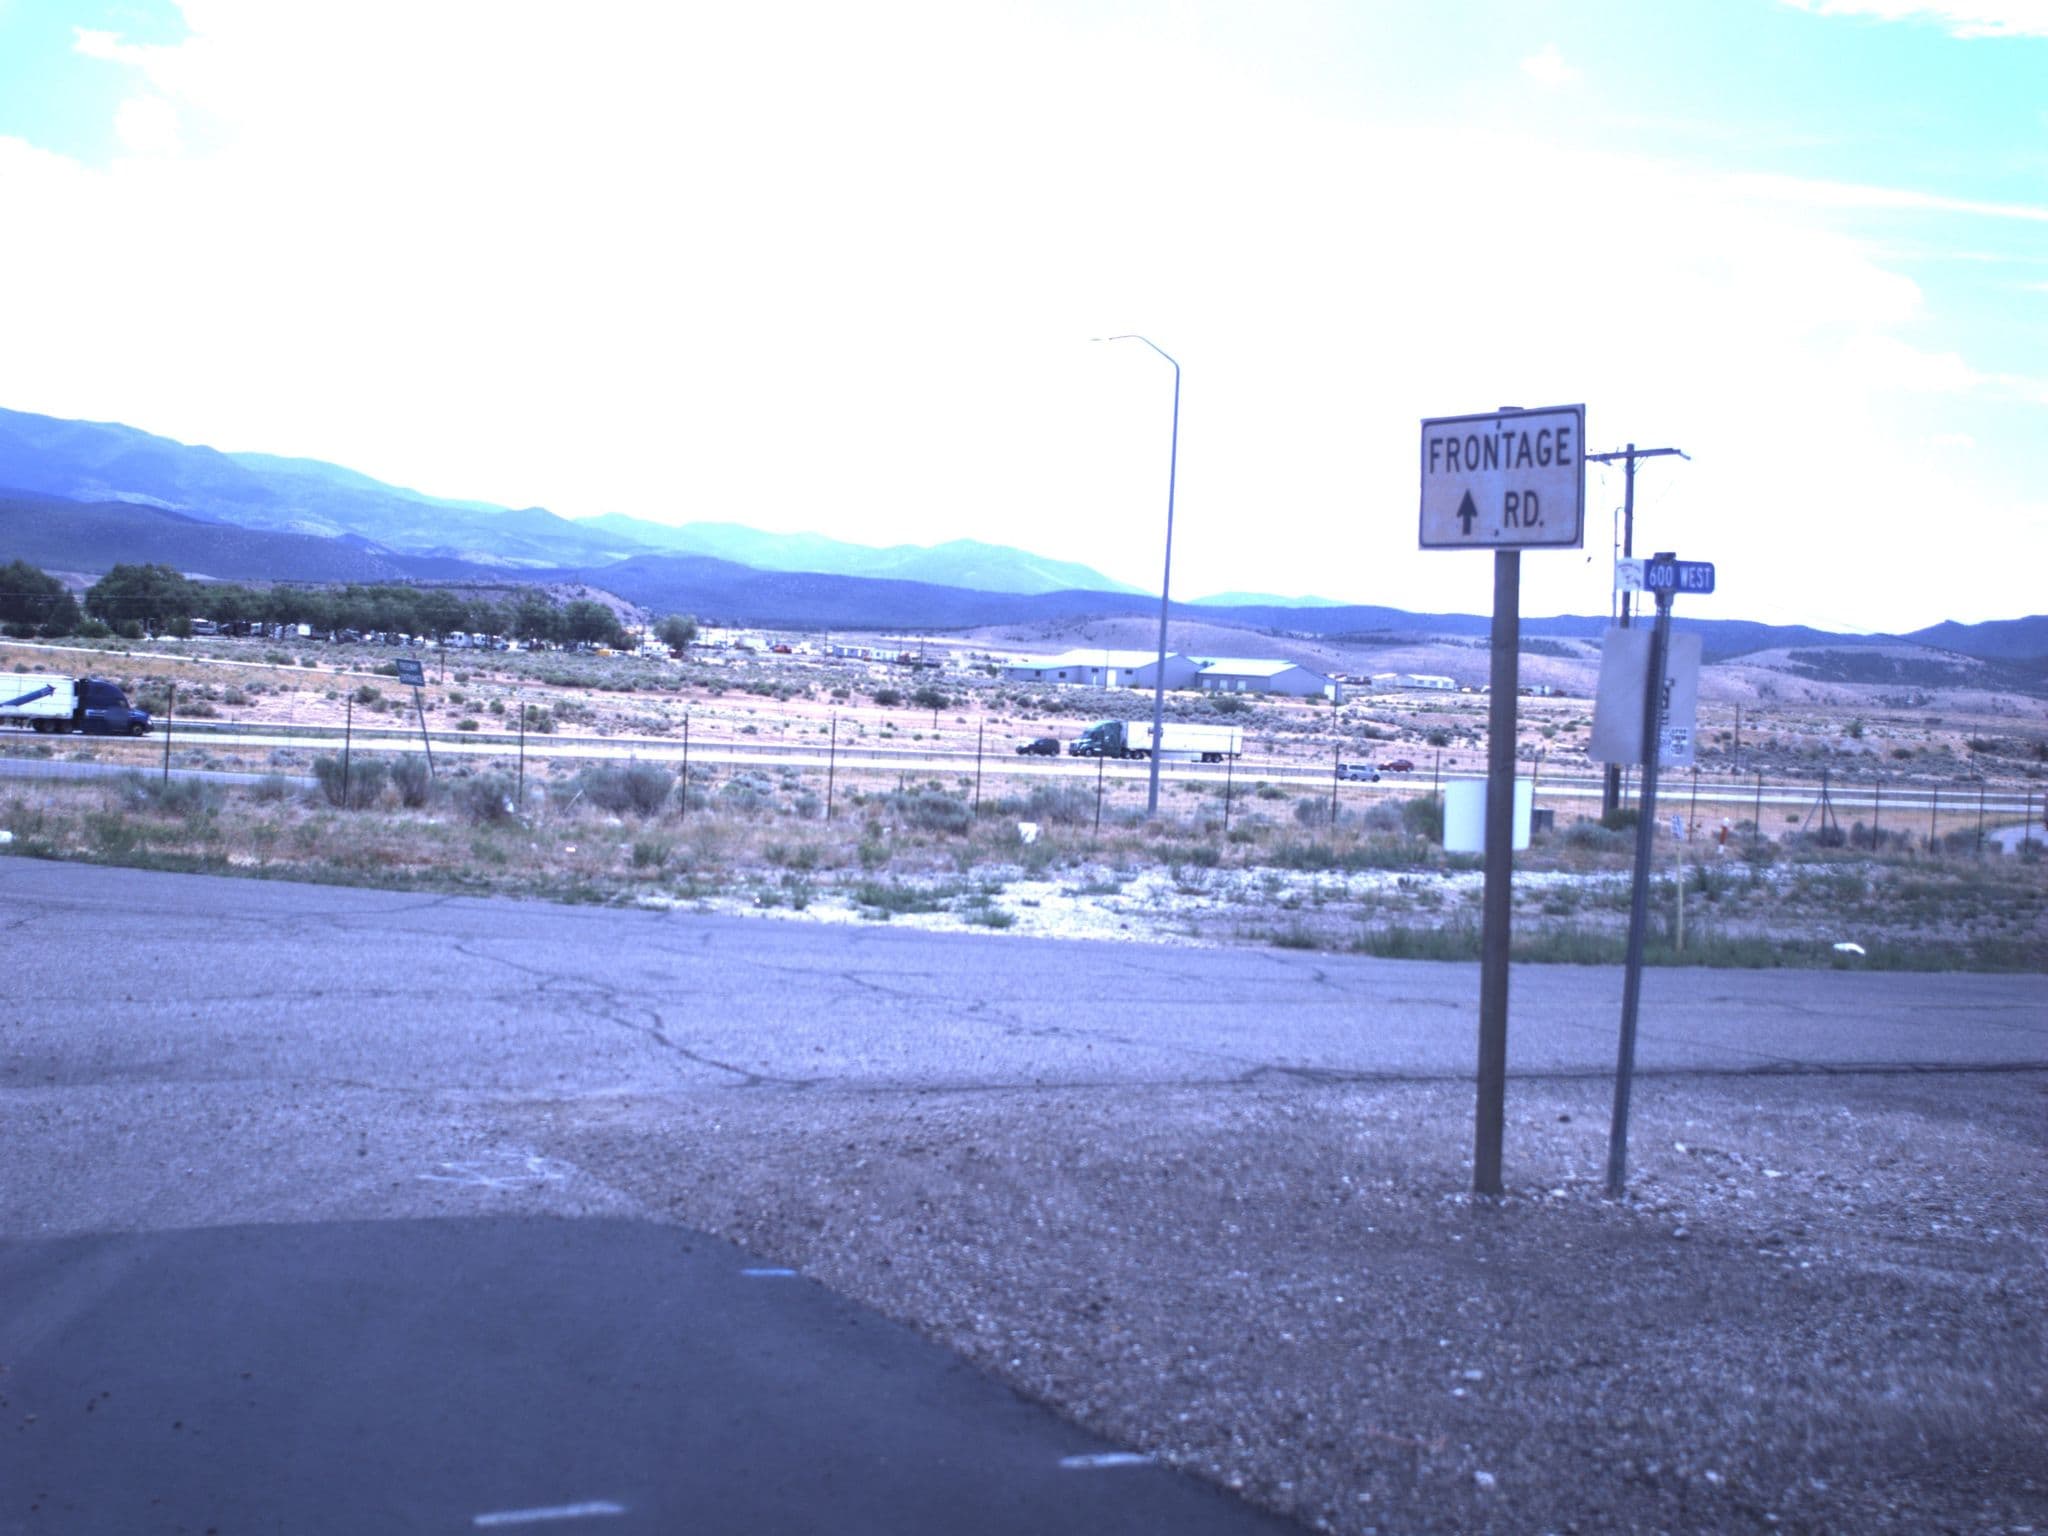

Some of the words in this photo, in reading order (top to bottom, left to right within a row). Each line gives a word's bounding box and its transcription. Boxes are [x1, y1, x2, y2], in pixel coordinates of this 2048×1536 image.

[1429, 427, 1571, 474] FRONTAGE
[1504, 490, 1544, 528] RD.
[1649, 565, 1673, 586] 600
[1680, 566, 1712, 588] WEST
